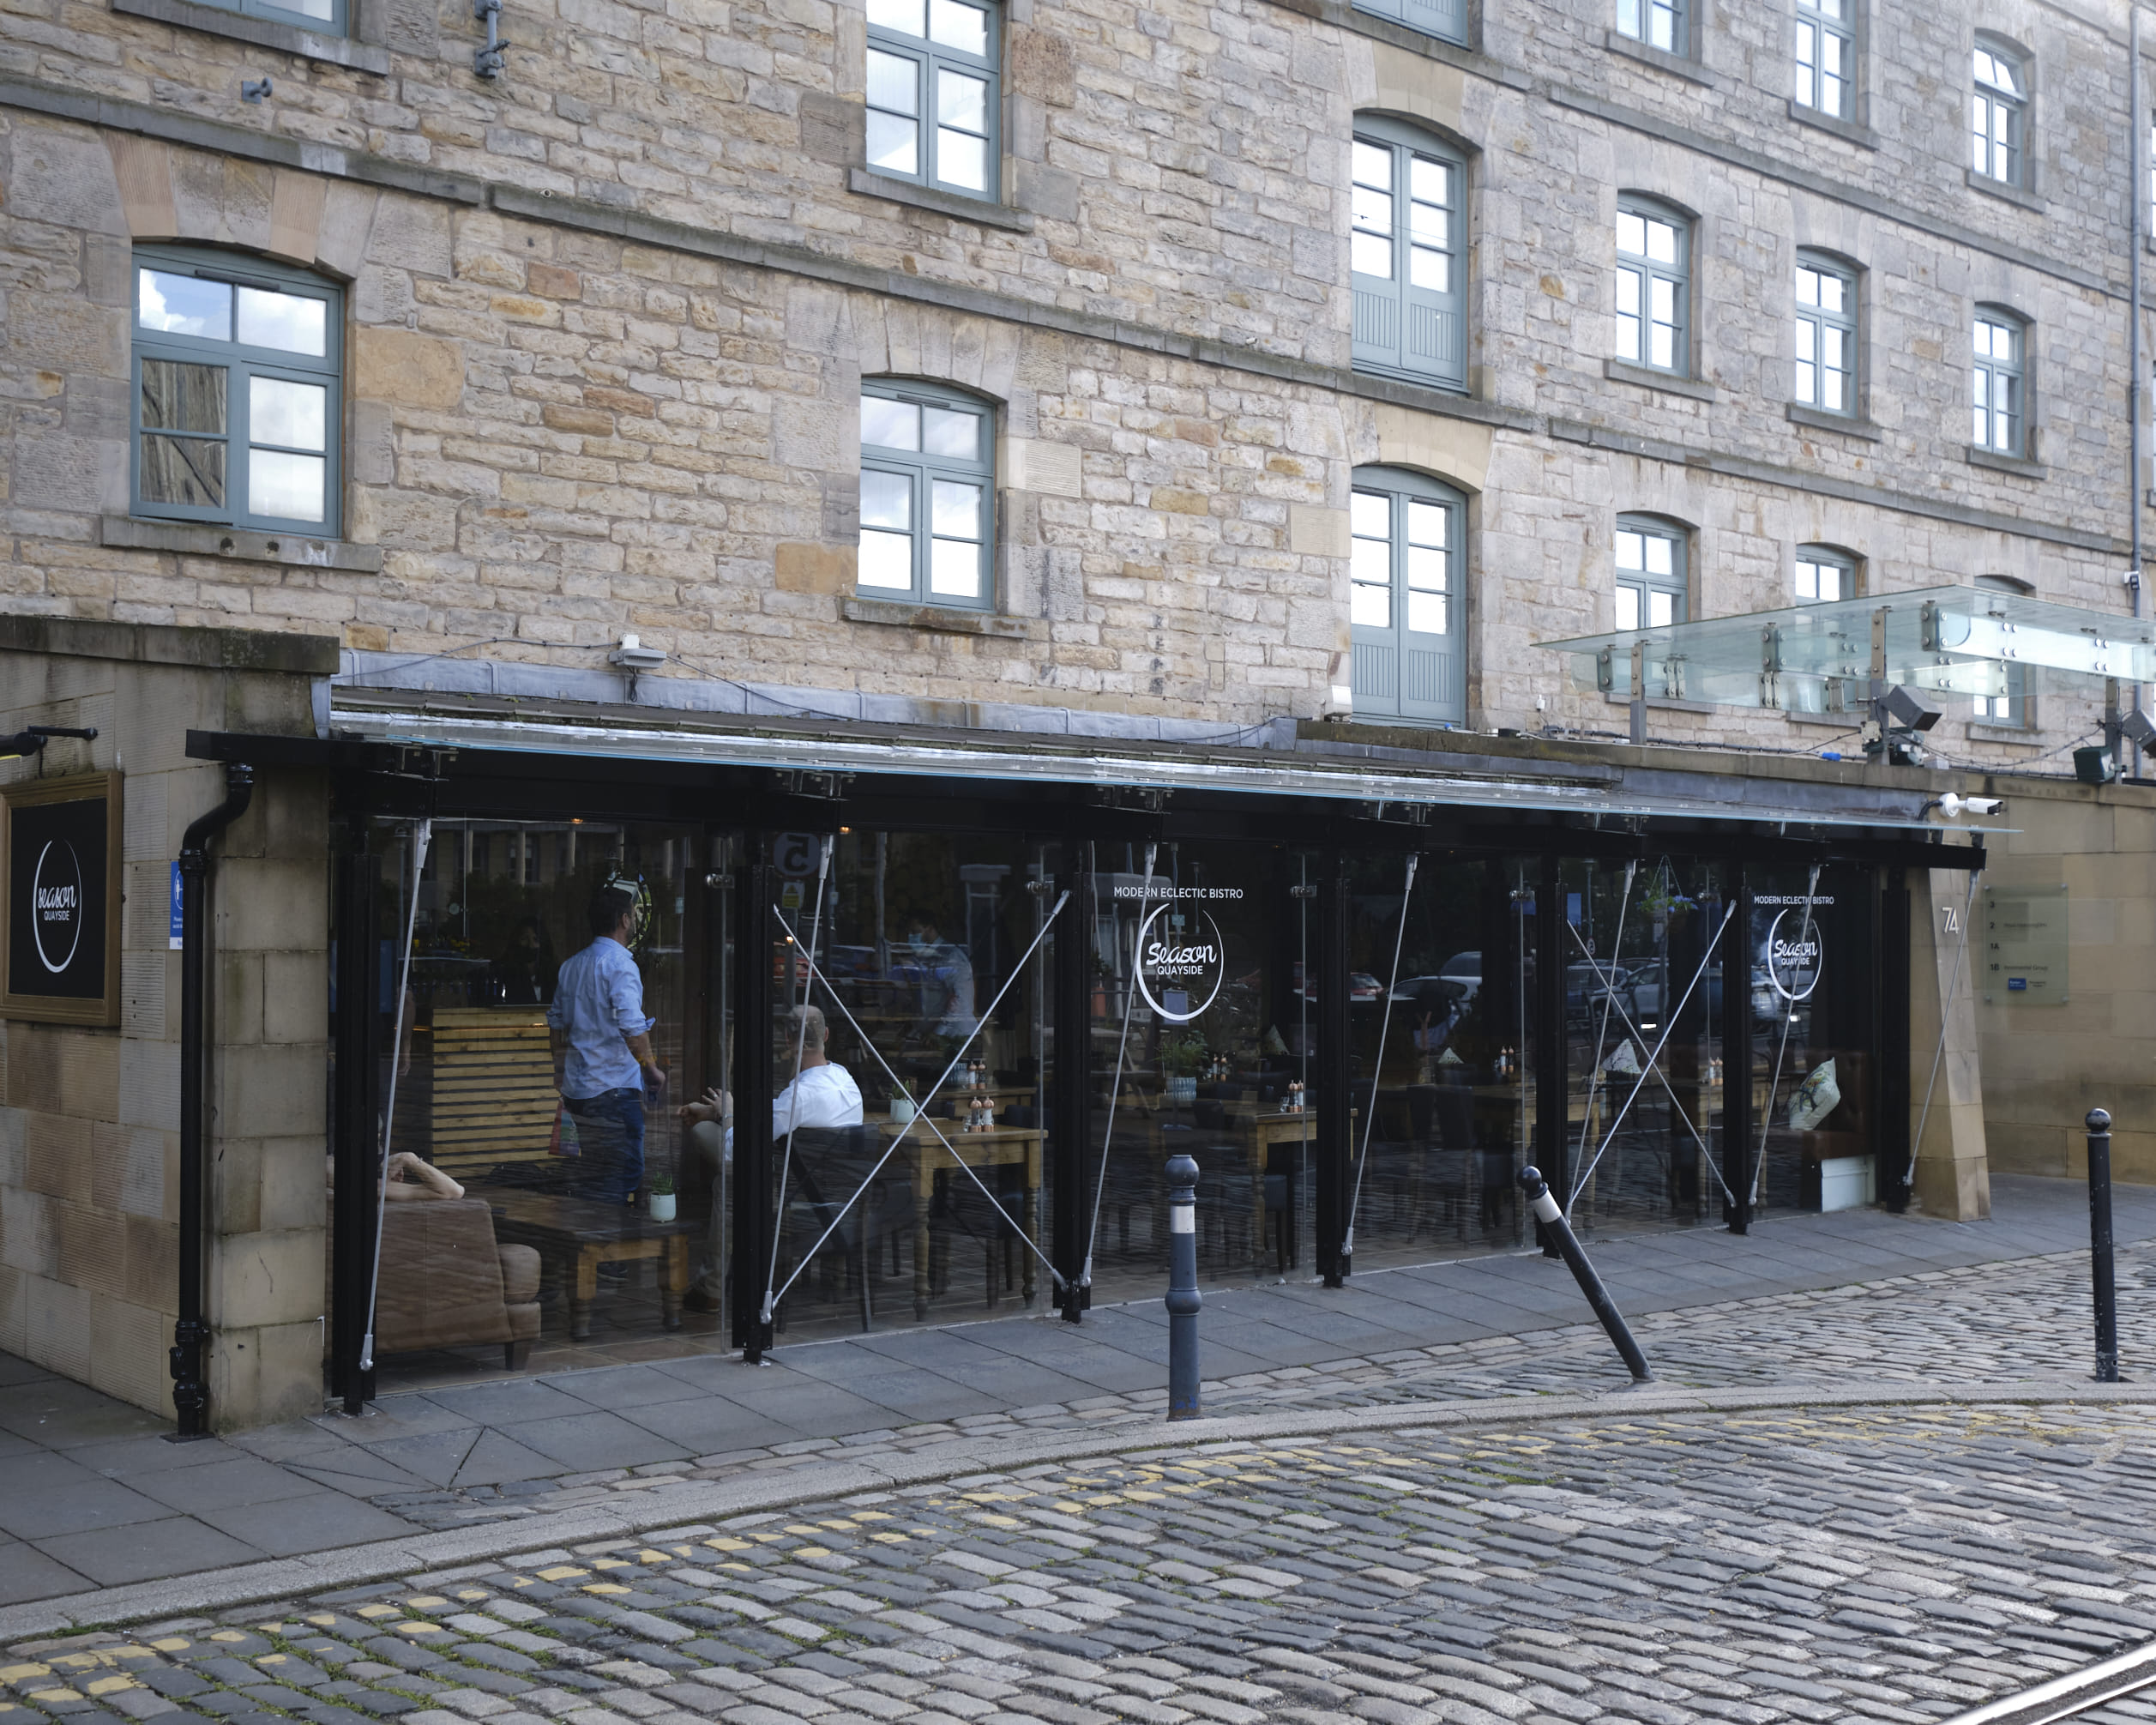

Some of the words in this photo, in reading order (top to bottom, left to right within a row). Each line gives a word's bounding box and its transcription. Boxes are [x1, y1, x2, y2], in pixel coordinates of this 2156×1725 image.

[1114, 886, 1158, 898] MODERN
[1160, 887, 1207, 899] ECLECTIC
[1209, 888, 1244, 899] BISTRO
[1754, 896, 1782, 905] MODERN
[1812, 896, 1834, 905] BISTRO
[44, 910, 69, 921] QUAYSIDE
[1942, 907, 1960, 933] 74
[1774, 938, 1818, 957] Season
[1146, 943, 1218, 966] Season
[1780, 957, 1810, 966] QUAYIDE
[1157, 965, 1203, 975] QUAYSIDE
